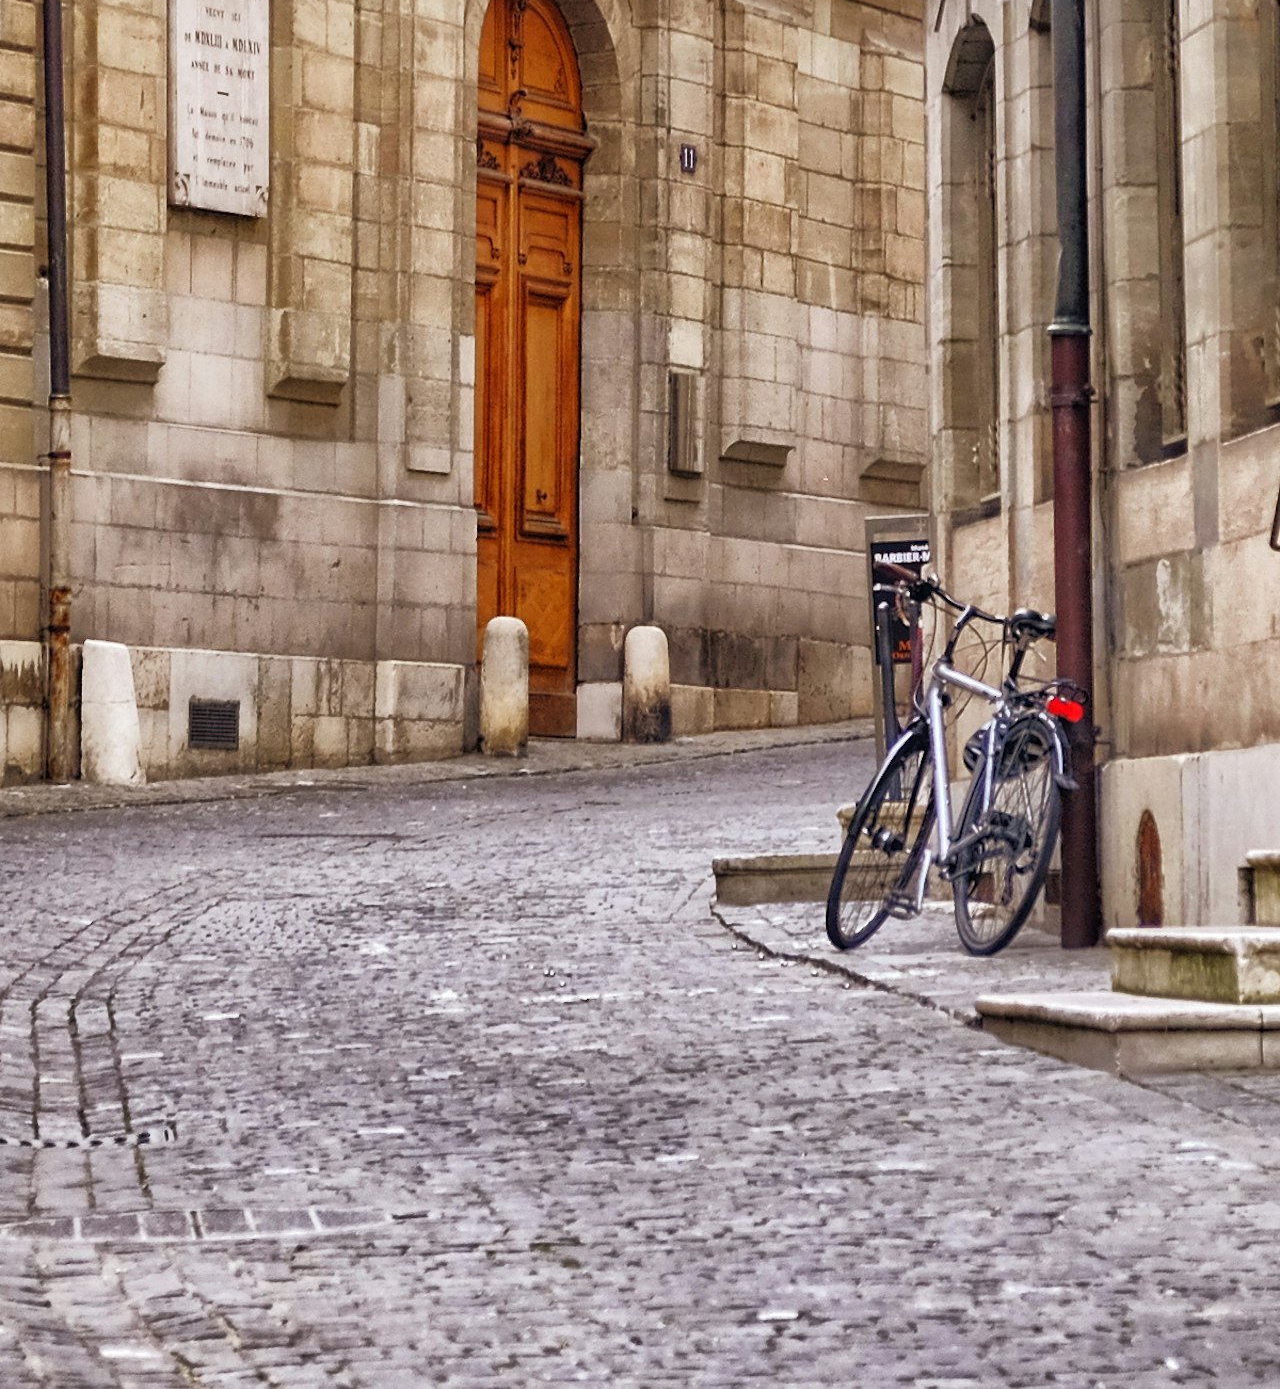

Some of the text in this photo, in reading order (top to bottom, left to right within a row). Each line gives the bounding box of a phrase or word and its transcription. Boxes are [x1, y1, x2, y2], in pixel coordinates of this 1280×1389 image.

[195, 30, 222, 49] MDXLIII
[232, 37, 261, 55] MDLXIV
[684, 148, 693, 169] 11
